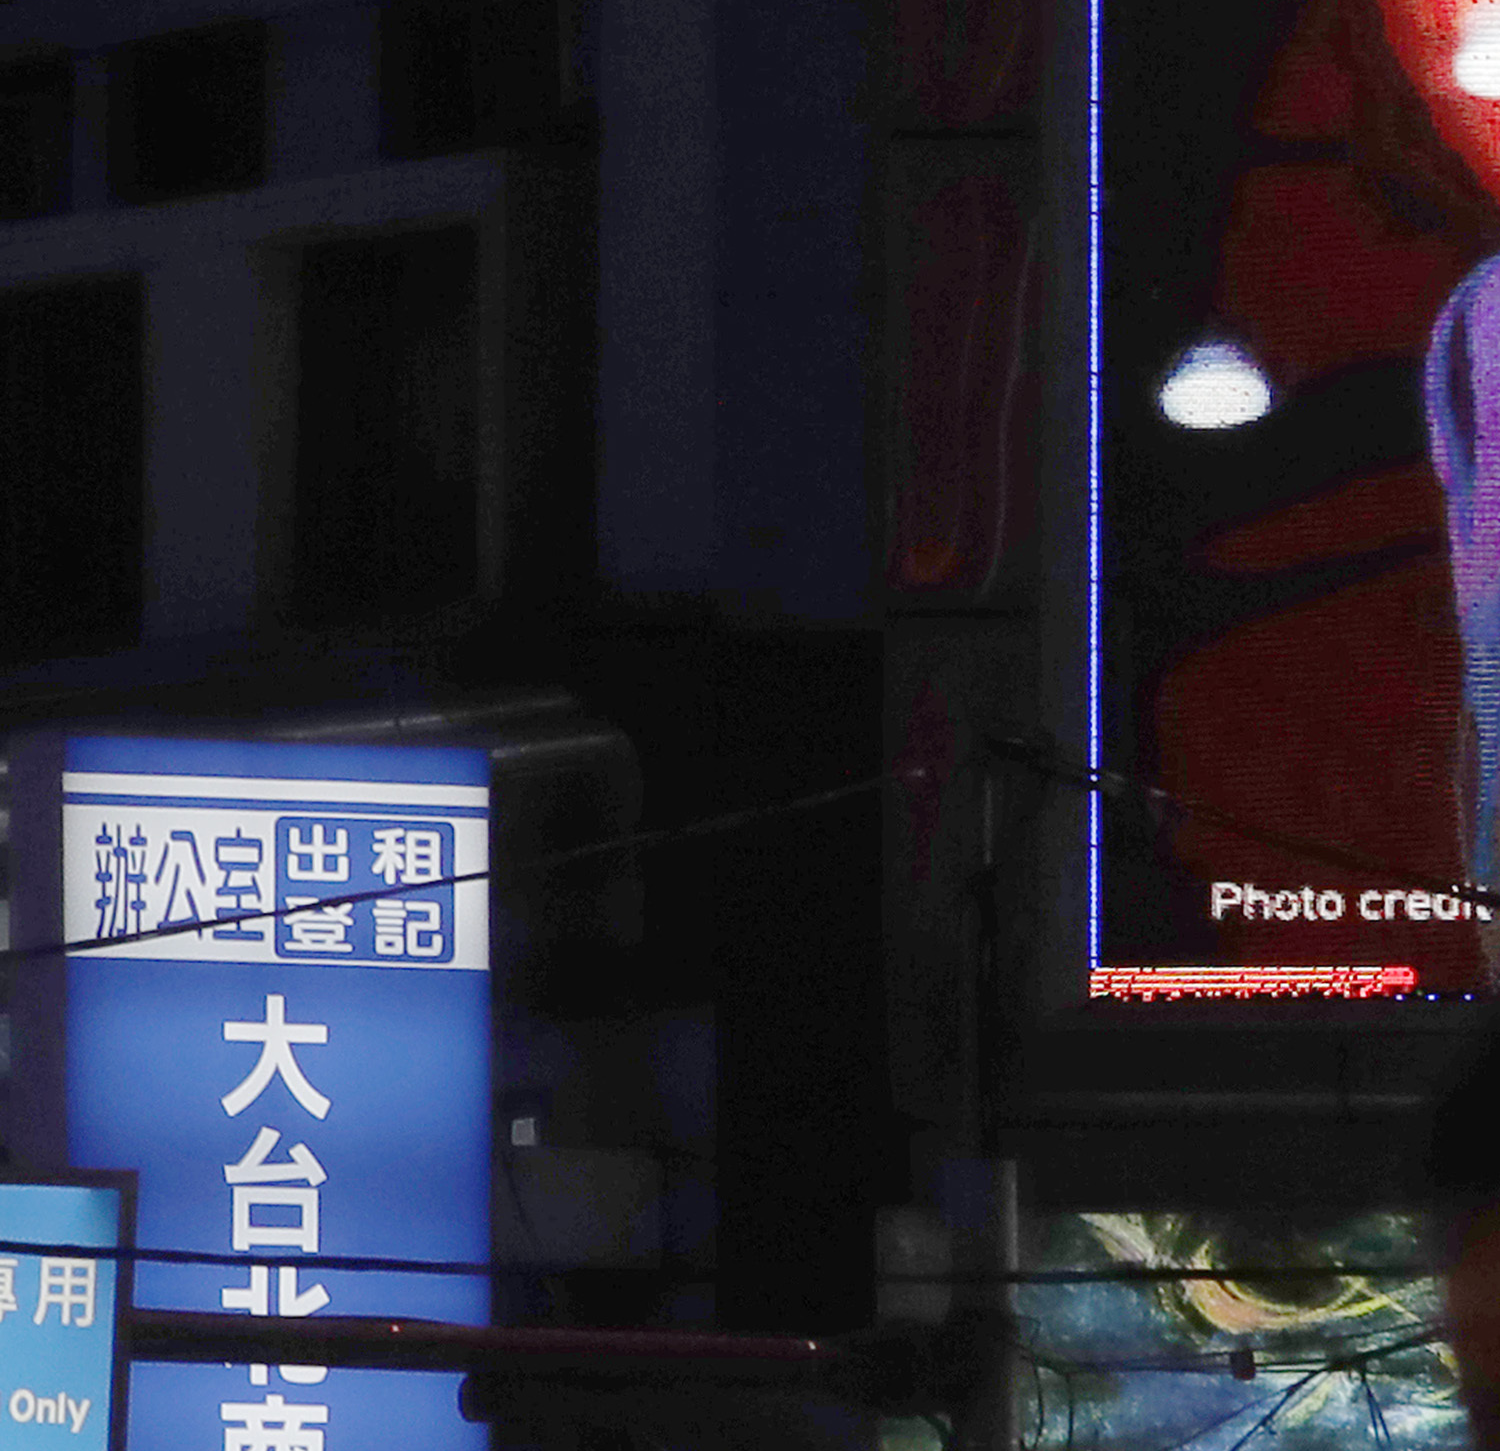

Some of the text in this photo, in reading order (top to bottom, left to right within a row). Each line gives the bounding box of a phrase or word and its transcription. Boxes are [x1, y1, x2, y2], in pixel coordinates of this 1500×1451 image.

[95, 821, 265, 944] 辦公室
[286, 822, 444, 887] 出租
[283, 898, 444, 959] 登記
[1210, 881, 1345, 921] Photo
[9, 1388, 91, 1435] Only
